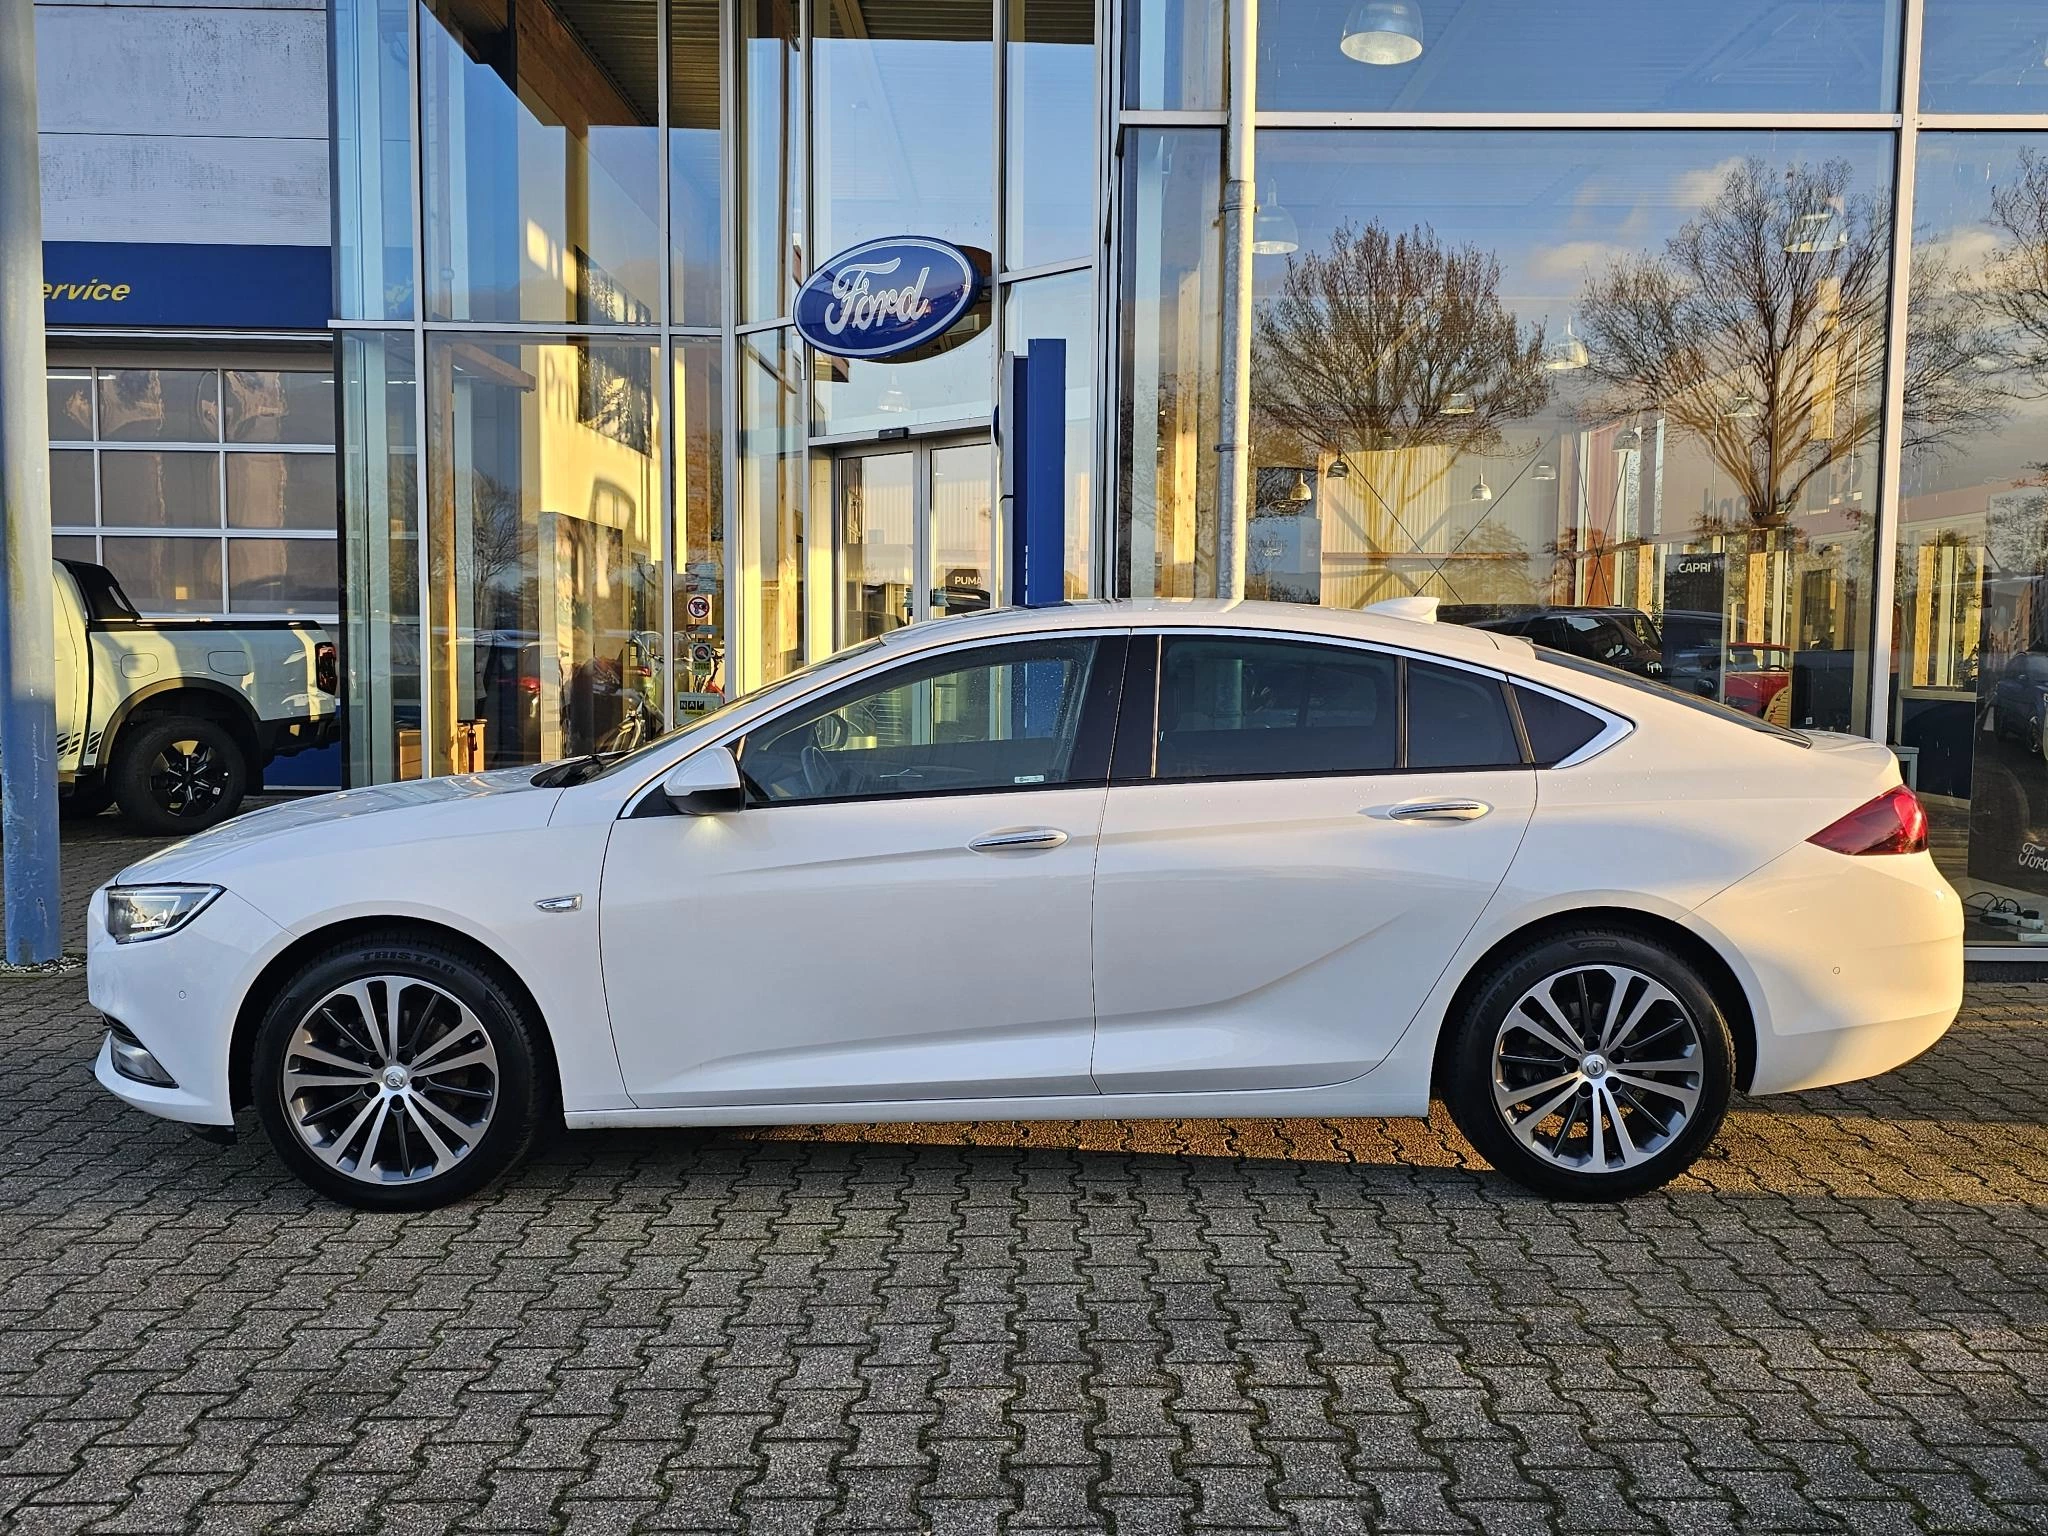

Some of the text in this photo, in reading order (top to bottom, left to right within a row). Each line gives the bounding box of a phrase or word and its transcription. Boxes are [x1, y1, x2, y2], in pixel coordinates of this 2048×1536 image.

[824, 257, 931, 335] Ford
[1678, 562, 1712, 574] CAPRI
[954, 576, 983, 585] PUMA
[360, 951, 458, 975] TRISTAR
